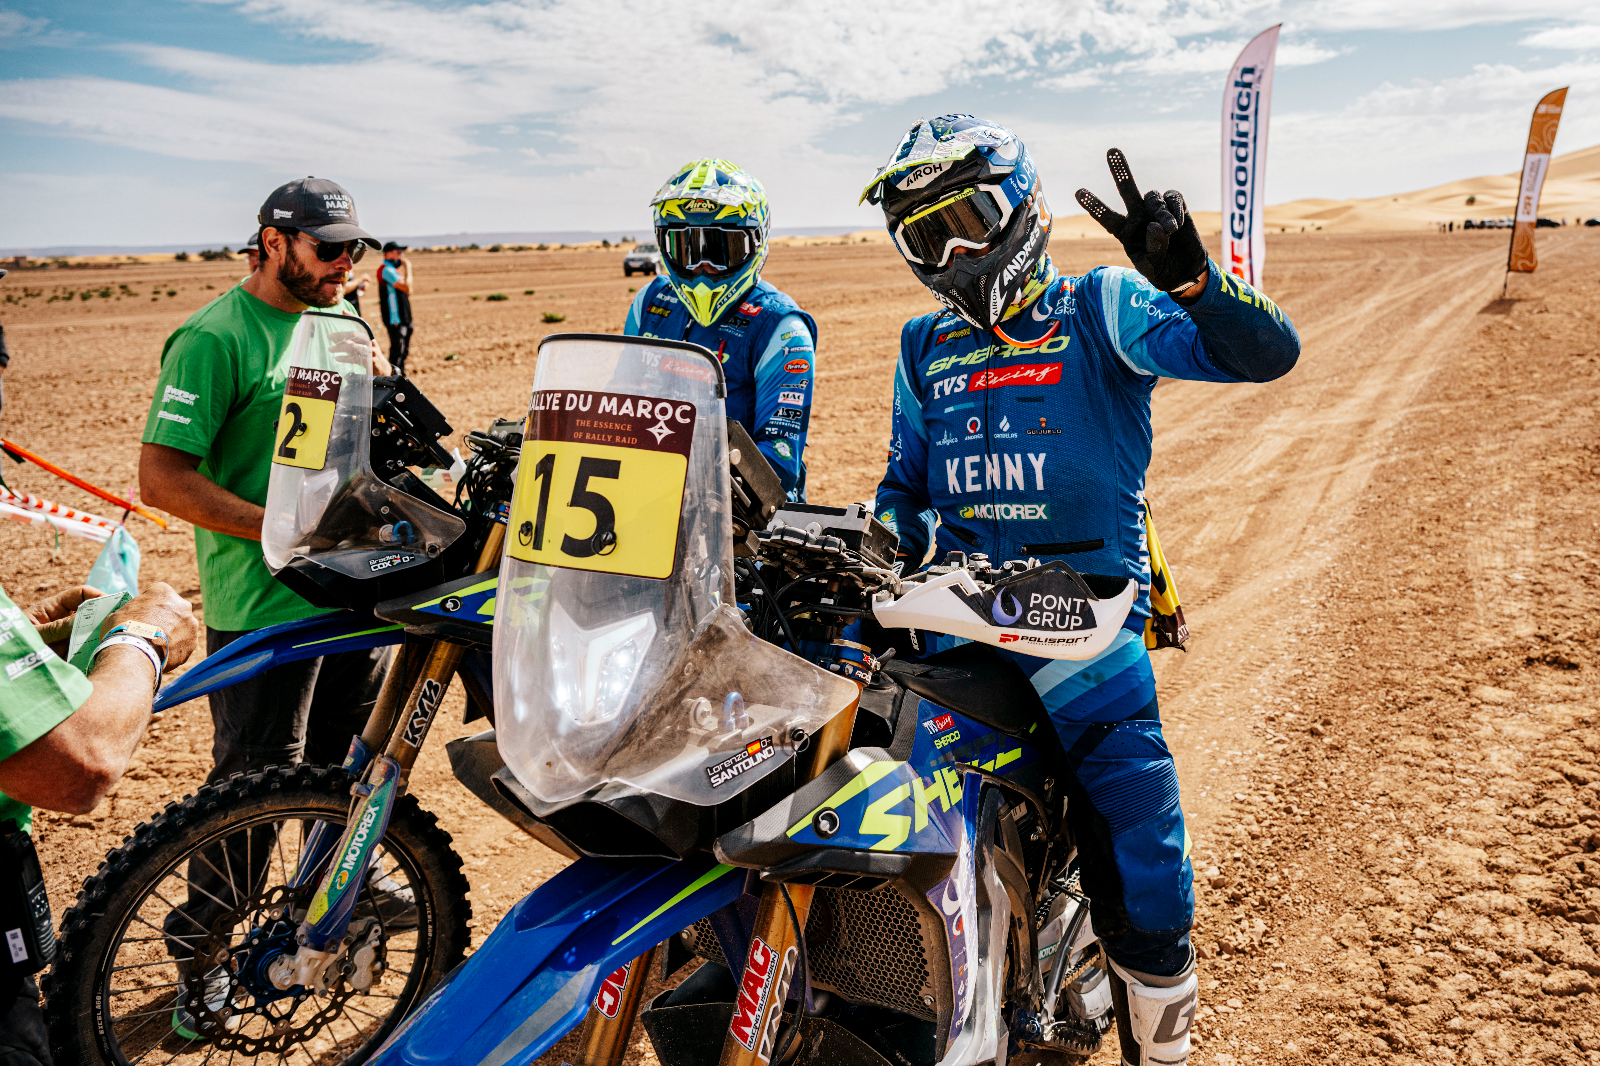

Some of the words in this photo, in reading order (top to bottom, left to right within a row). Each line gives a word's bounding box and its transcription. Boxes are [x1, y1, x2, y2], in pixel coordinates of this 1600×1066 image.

[906, 164, 944, 188] AIROH
[686, 199, 714, 210] Airoh
[297, 369, 340, 385] MAROC
[933, 373, 968, 400] TVS
[975, 365, 1060, 388] Racing
[565, 393, 592, 412] DU
[597, 397, 691, 424] MAROC
[278, 402, 302, 459] 2
[575, 419, 591, 427] THE
[593, 421, 632, 432] ESSENCE
[573, 432, 583, 440] OF
[585, 433, 612, 443] RALLY
[614, 436, 638, 445] RAID
[945, 453, 1047, 494] KENNY
[532, 453, 622, 559] 15
[973, 504, 1047, 520] MOTOREX
[370, 560, 392, 571] COX
[1029, 593, 1084, 614] PONT
[1027, 609, 1082, 630] GRUP
[1020, 636, 1089, 644] POLISPORT
[401, 678, 442, 748] KYB
[933, 730, 961, 750] SHERCO
[706, 751, 749, 776] Lorenzo
[710, 745, 775, 788] SANTOLINO
[342, 804, 379, 871] MOTOREX
[731, 938, 773, 1045] MAC
[757, 953, 778, 1011] SUSPENSION
